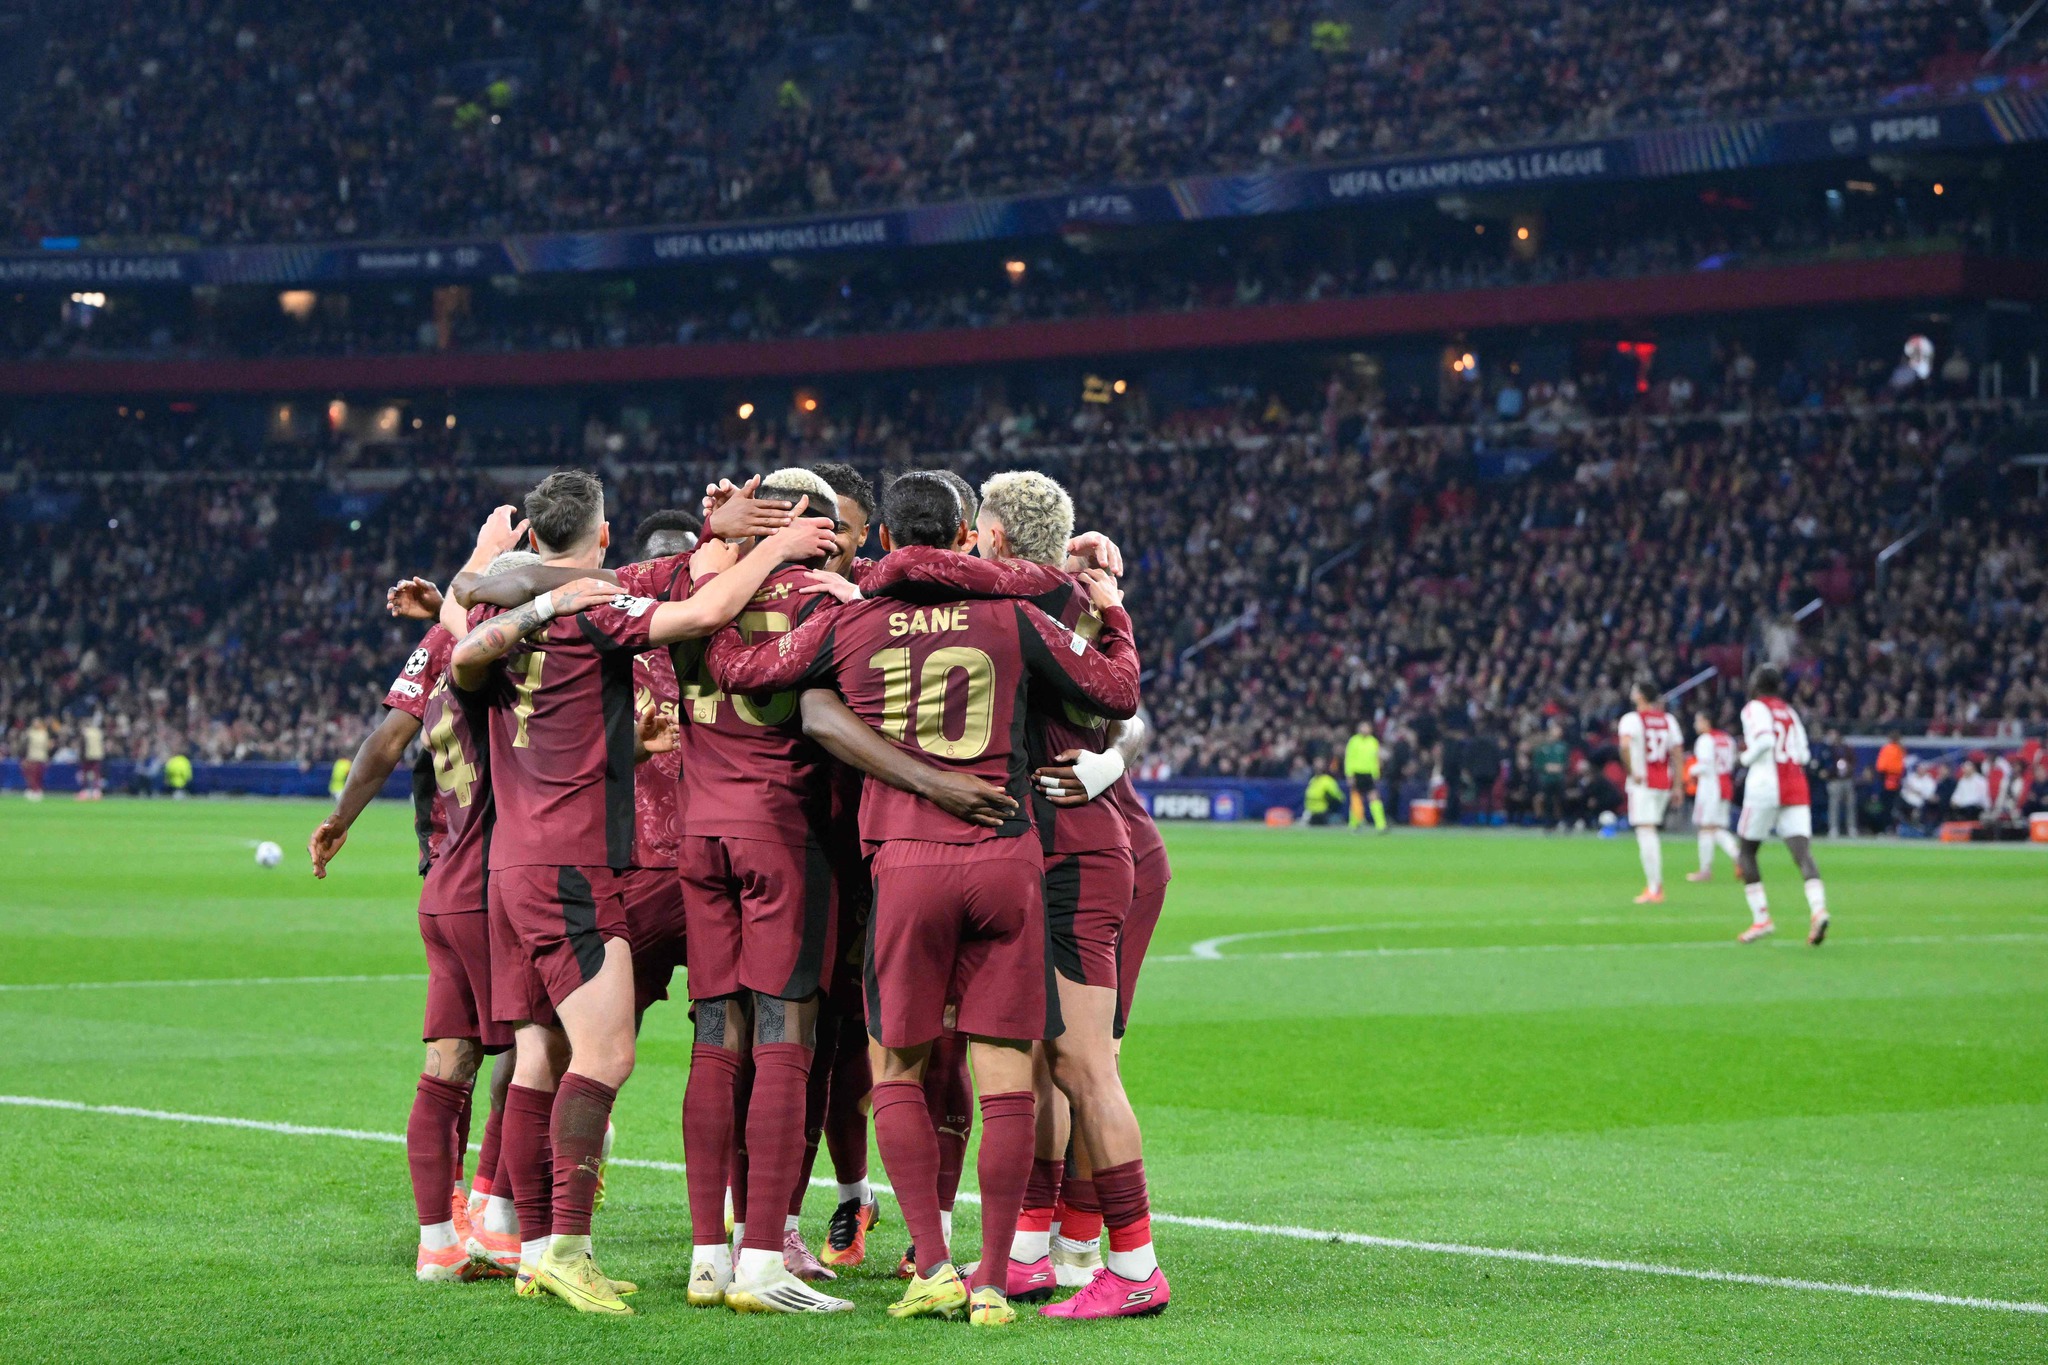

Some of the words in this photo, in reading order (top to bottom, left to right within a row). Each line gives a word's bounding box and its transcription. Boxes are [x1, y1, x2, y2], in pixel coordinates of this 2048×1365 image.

[1871, 117, 1940, 143] PEPSI
[1328, 170, 1384, 198] UEFA
[1385, 156, 1516, 193] CHAMPIONS
[1518, 148, 1606, 180] LEAGUE
[707, 225, 818, 256] CHAMPIONS
[818, 219, 887, 247] LEAGUE
[888, 600, 971, 637] SANÉ
[869, 646, 996, 760] 10
[1153, 795, 1211, 818] PEPSI
